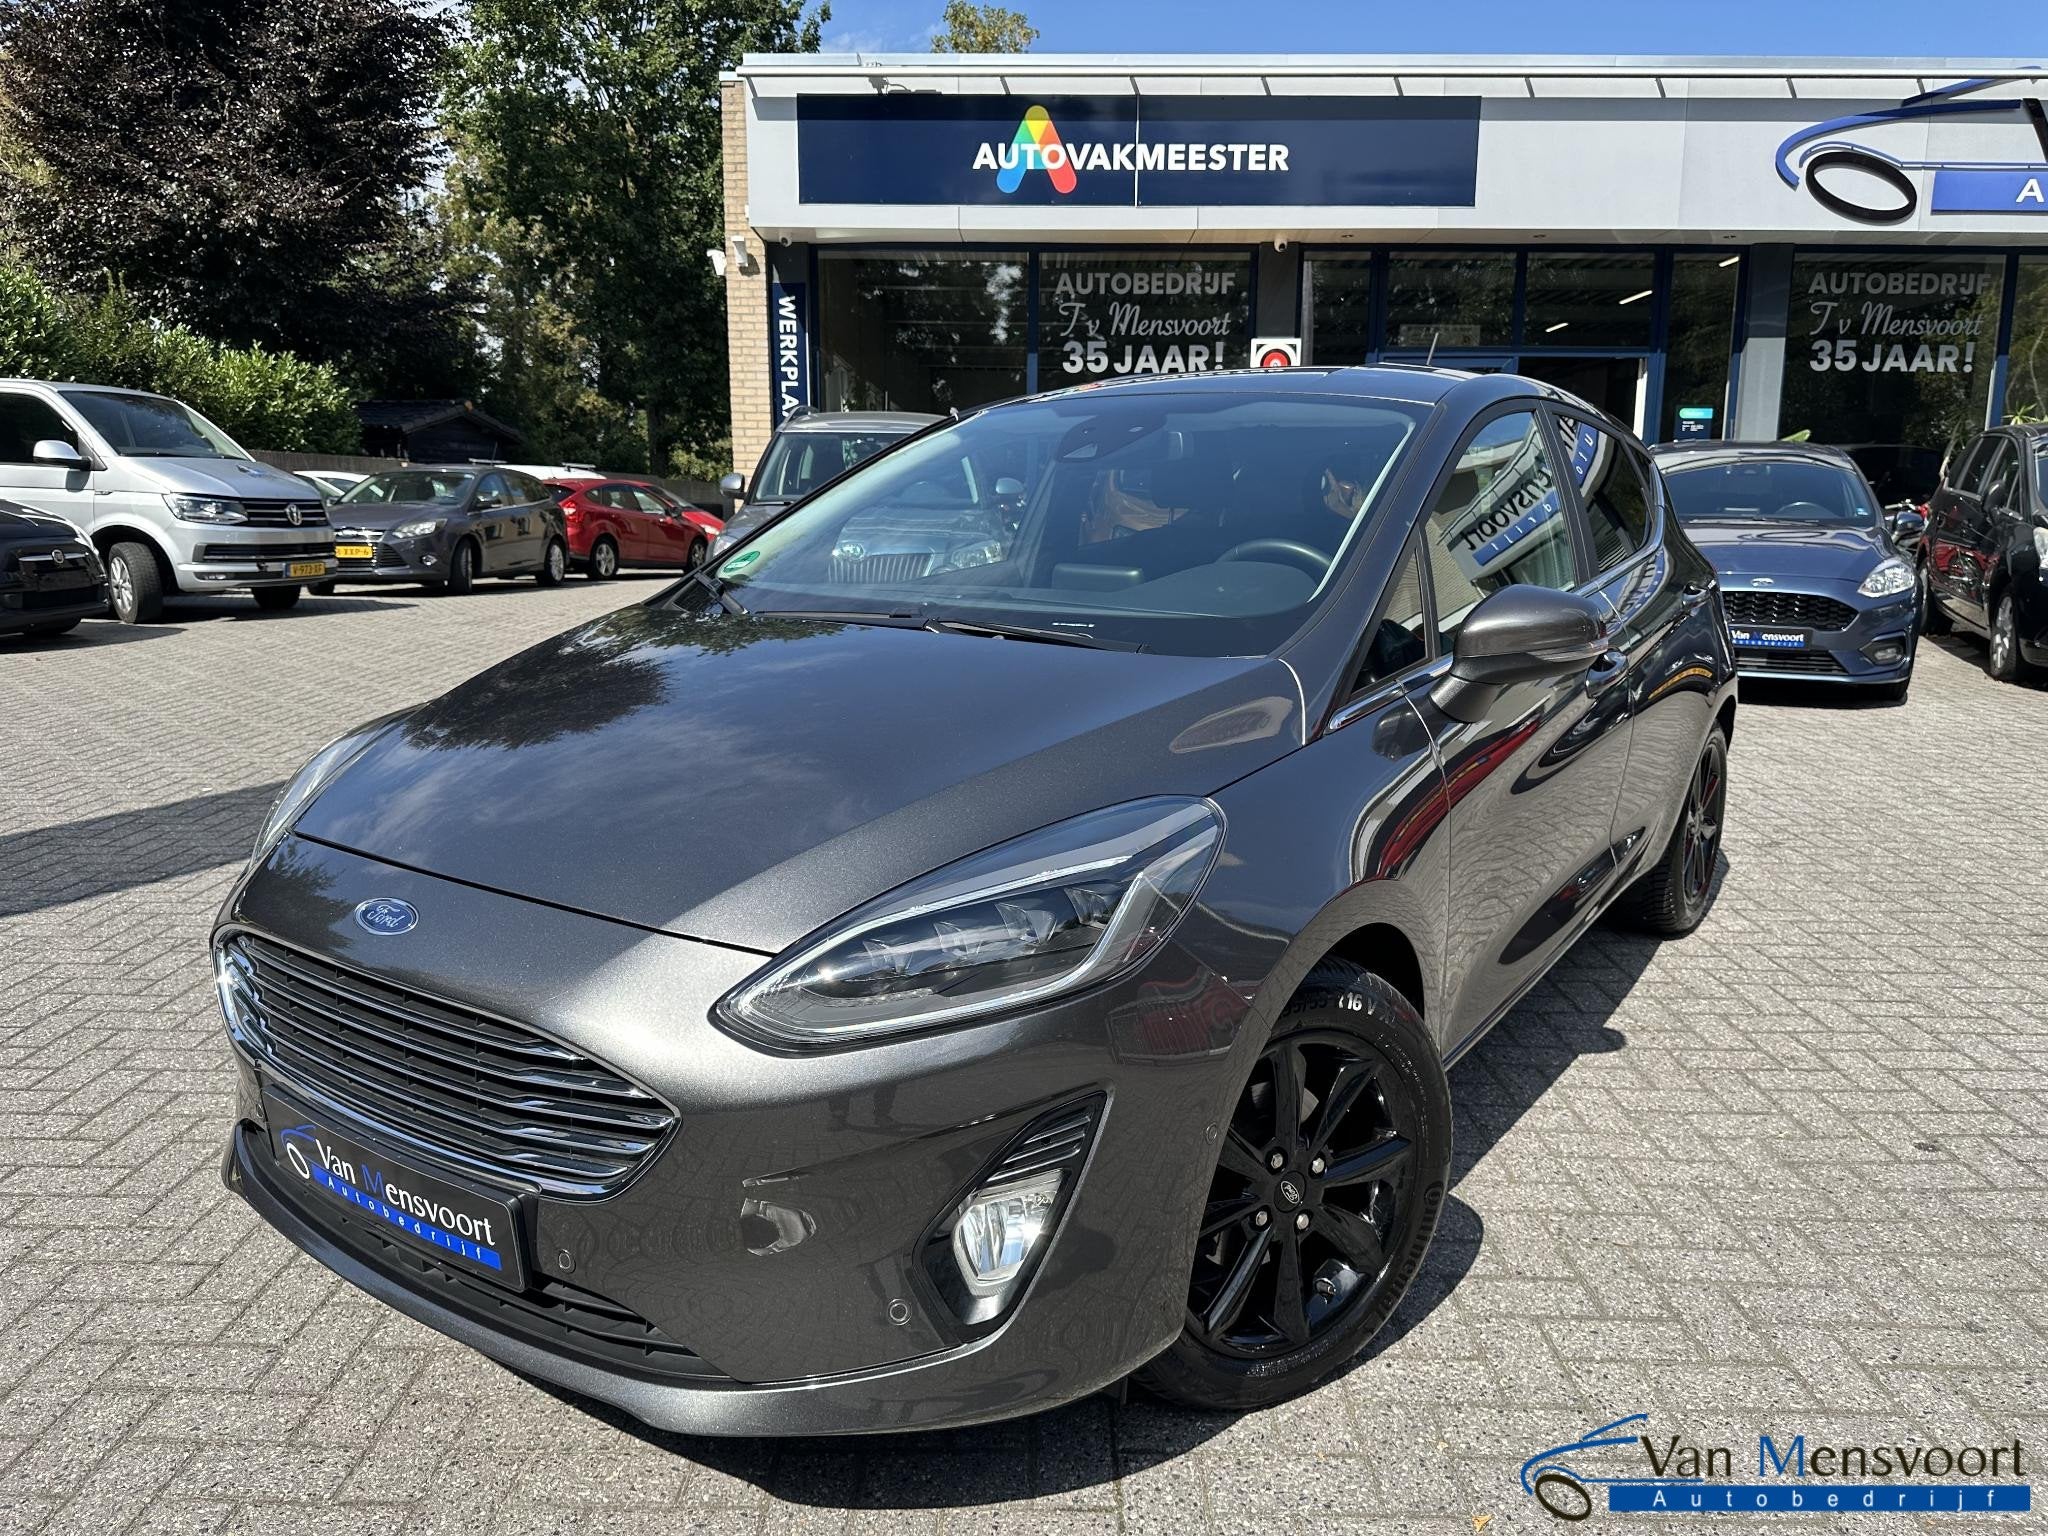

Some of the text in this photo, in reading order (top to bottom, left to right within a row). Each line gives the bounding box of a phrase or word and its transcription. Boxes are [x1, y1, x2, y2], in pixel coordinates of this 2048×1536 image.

[973, 143, 1289, 171] AUTOVAKMEESTER
[1055, 272, 1236, 295] AUTOBEDRIJF
[1808, 272, 1992, 295] AUTOBEDRIJF
[1108, 301, 1232, 336] Mensvoort
[1860, 301, 1984, 336] Mensvoort
[1062, 340, 1225, 374] 35 JAAR!
[1809, 340, 1975, 373] 35 JAAR!
[366, 904, 405, 928] Ford
[315, 1138, 496, 1246] Van Mensvoort
[327, 1179, 482, 1260] Autobedrijf
